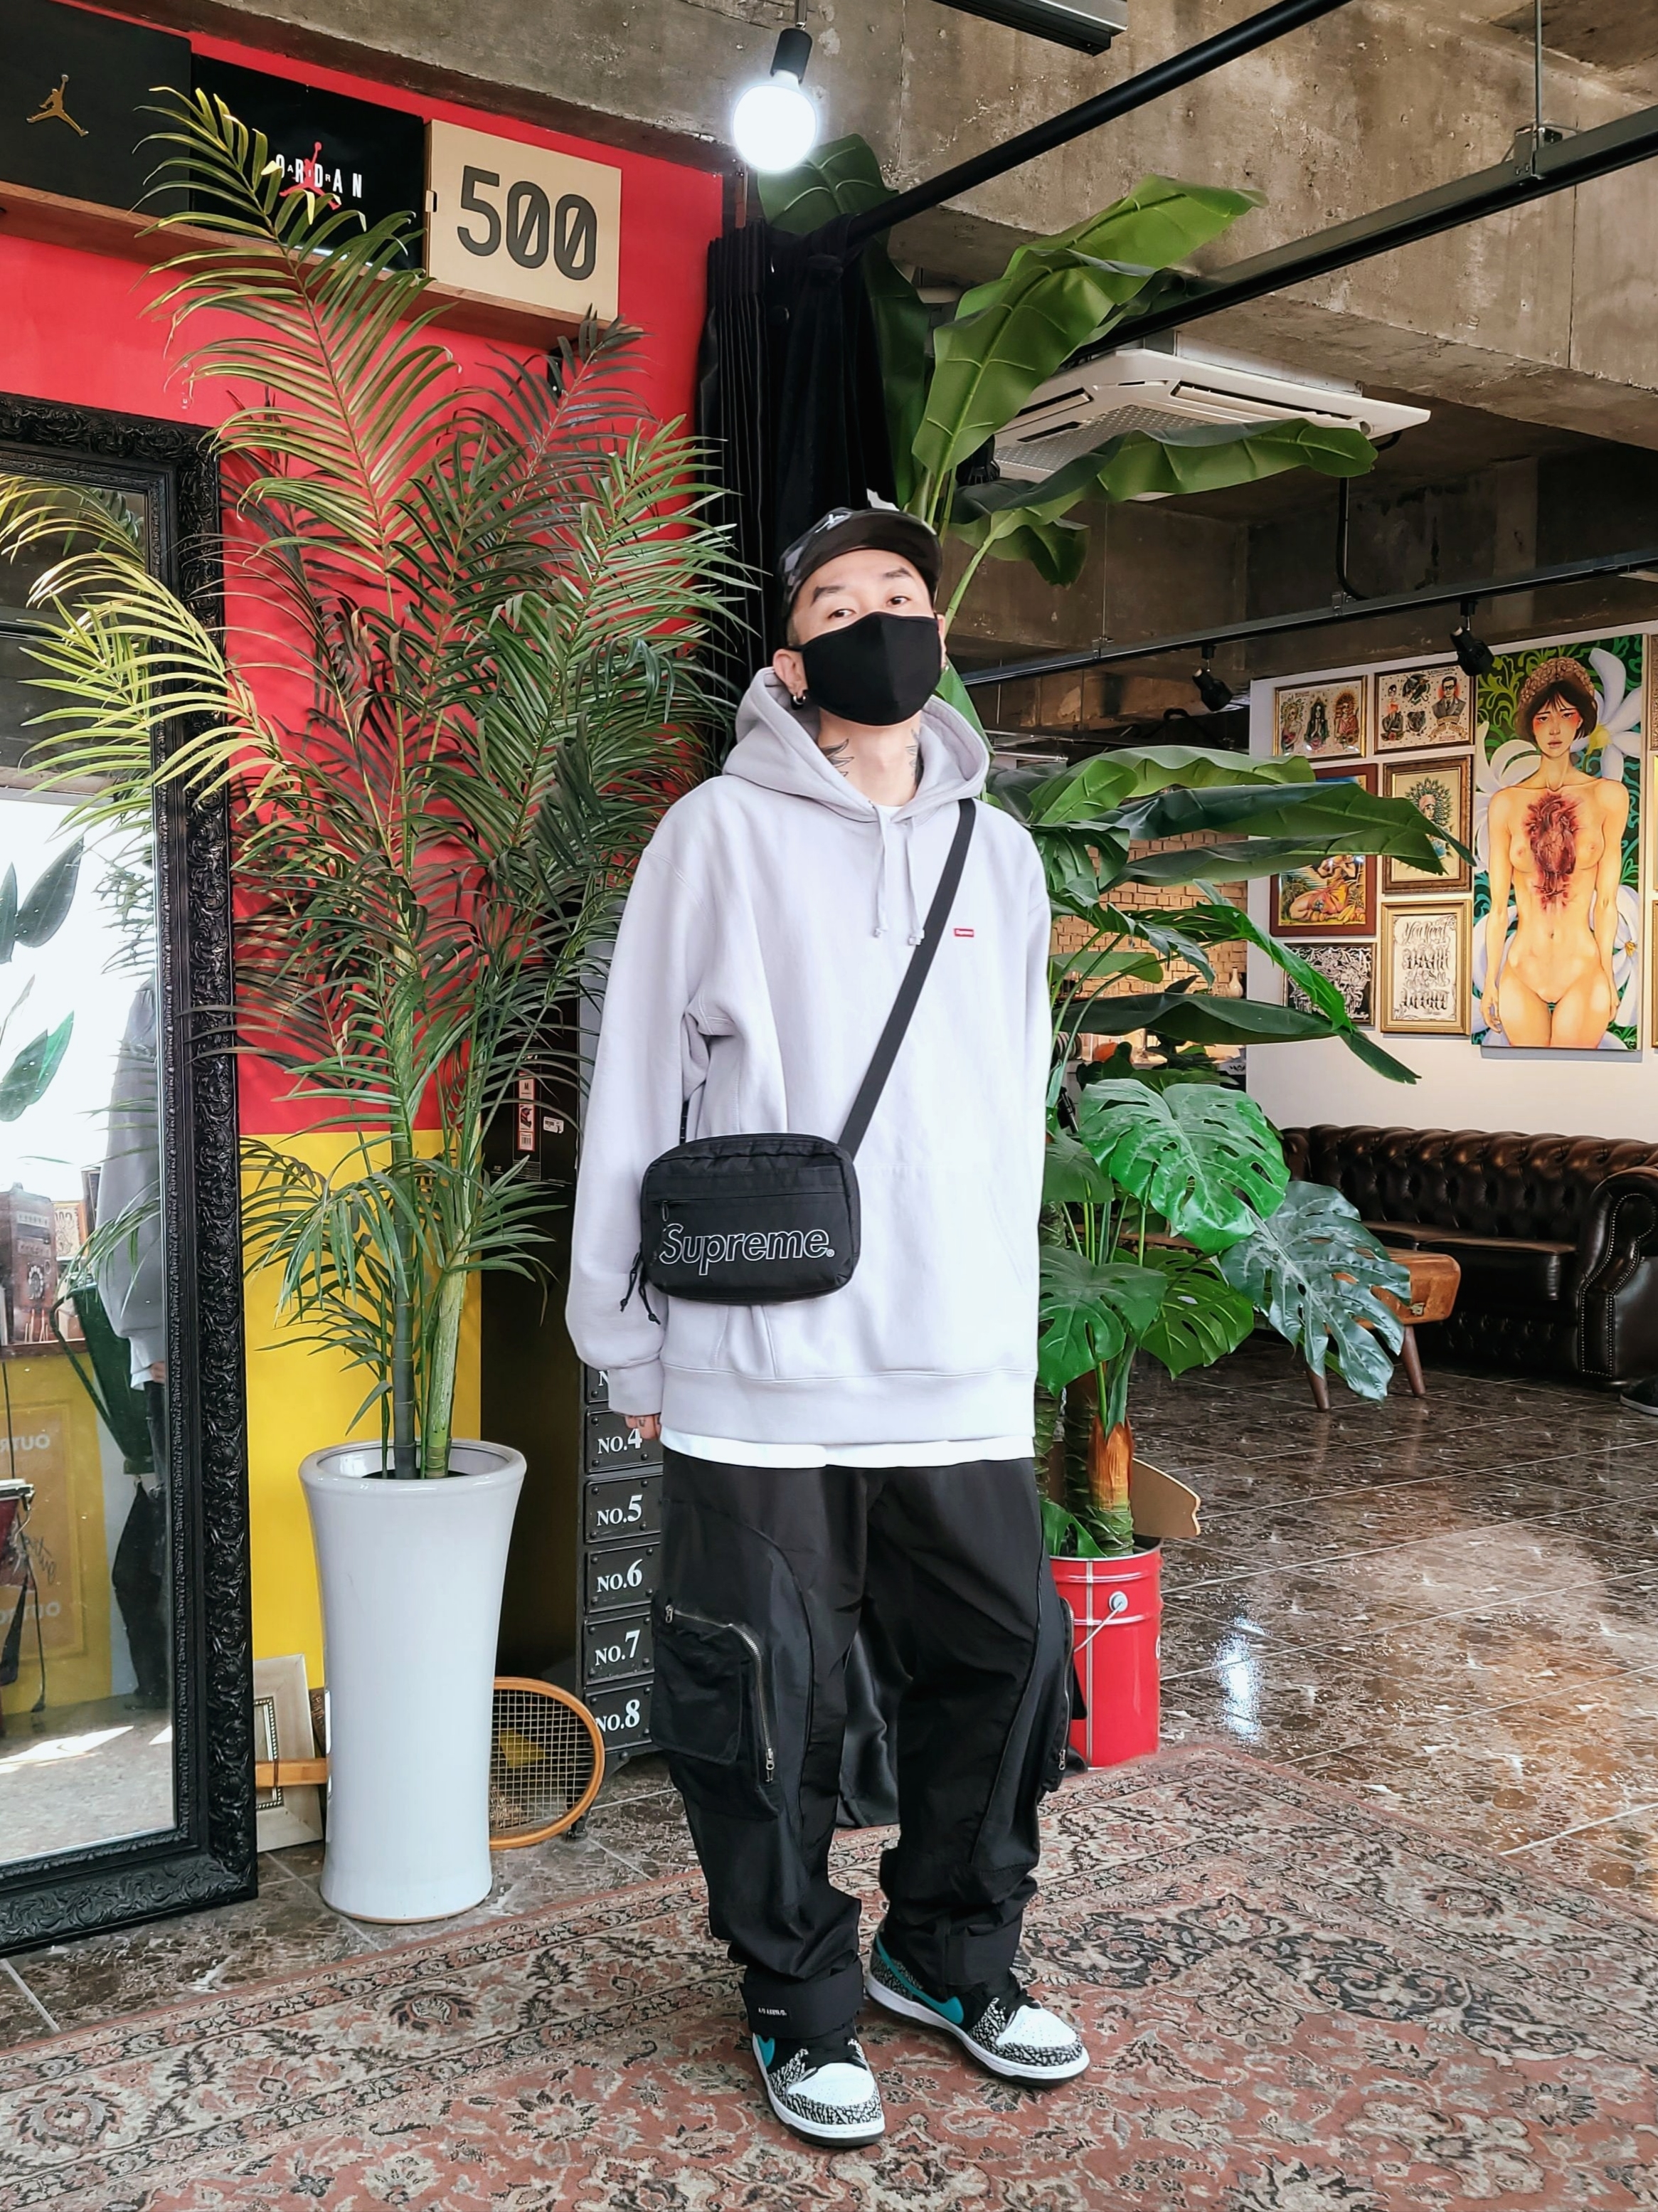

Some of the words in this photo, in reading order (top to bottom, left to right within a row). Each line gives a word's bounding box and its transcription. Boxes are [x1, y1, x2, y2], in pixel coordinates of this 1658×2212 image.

[275, 153, 362, 199] ORDAN
[457, 164, 597, 281] 500
[659, 1222, 830, 1276] Supreme
[597, 1427, 643, 1454] NO.4
[596, 1494, 643, 1527] NO.5
[596, 1559, 643, 1593] NO.6
[595, 1629, 641, 1666] NO.7
[595, 1698, 641, 1733] NO.8
